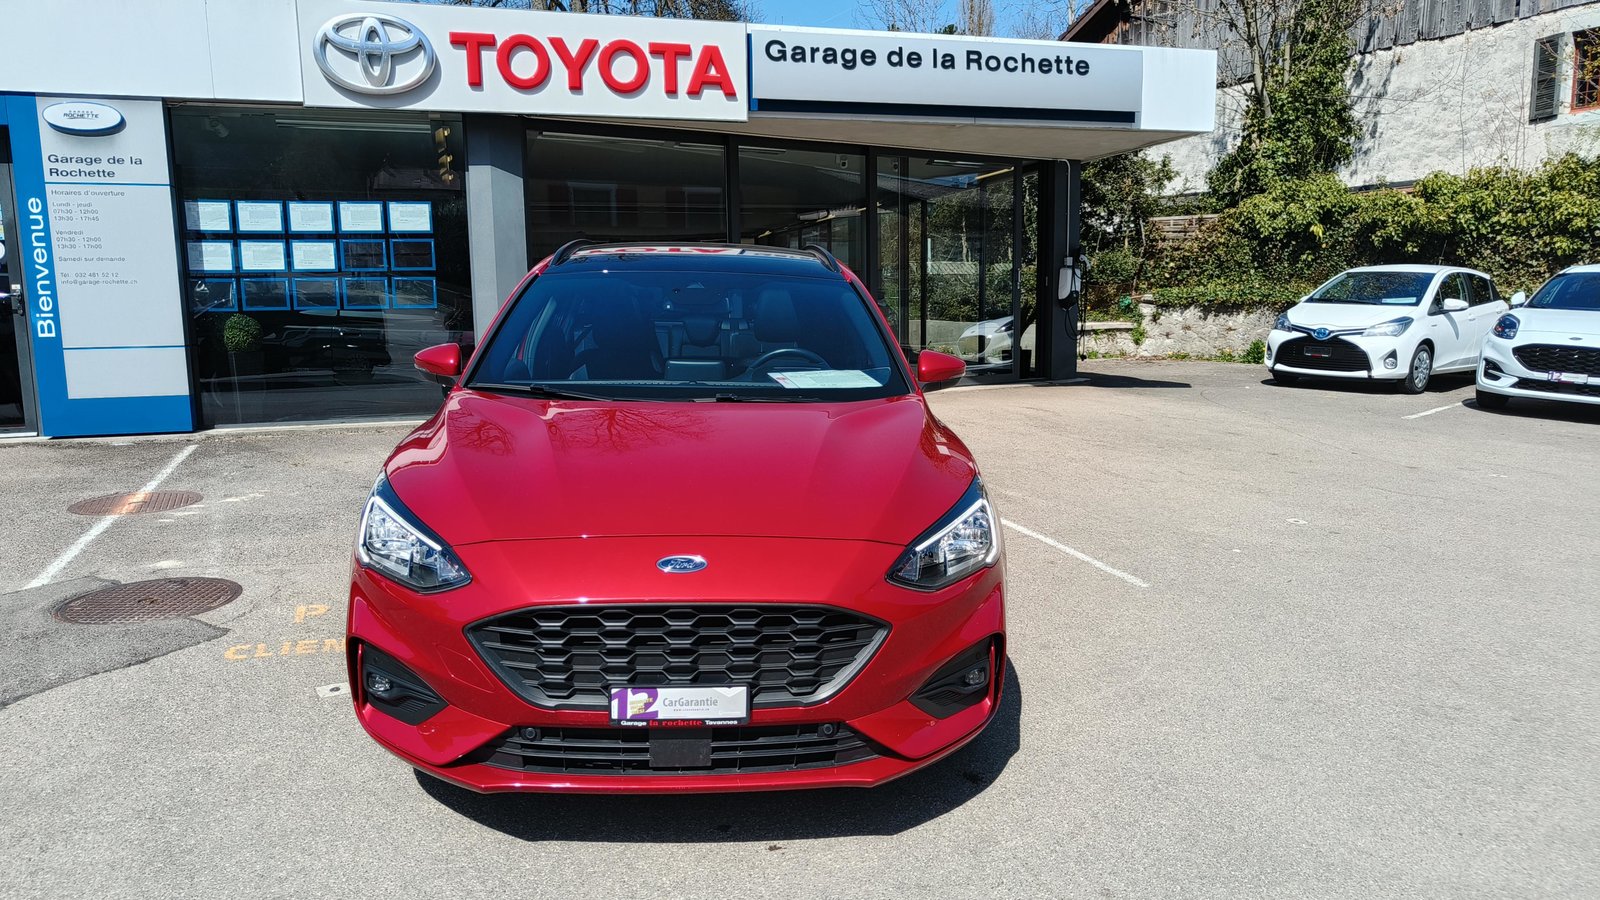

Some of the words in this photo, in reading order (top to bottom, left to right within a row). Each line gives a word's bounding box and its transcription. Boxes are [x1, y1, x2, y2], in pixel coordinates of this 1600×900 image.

[449, 31, 737, 97] TOYOTA
[765, 39, 877, 70] Garage
[886, 46, 923, 68] de
[932, 48, 956, 69] la
[965, 50, 1090, 76] Rochette
[47, 154, 102, 166] Garage
[107, 155, 125, 165] de
[130, 156, 143, 165] la
[49, 167, 116, 178] Rochette
[83, 189, 125, 197] d'ouverture
[28, 197, 56, 338] Bienvenue
[667, 559, 695, 569] Ford
[294, 603, 331, 624] P
[611, 687, 659, 720] 12
[662, 697, 719, 708] CarGarantie
